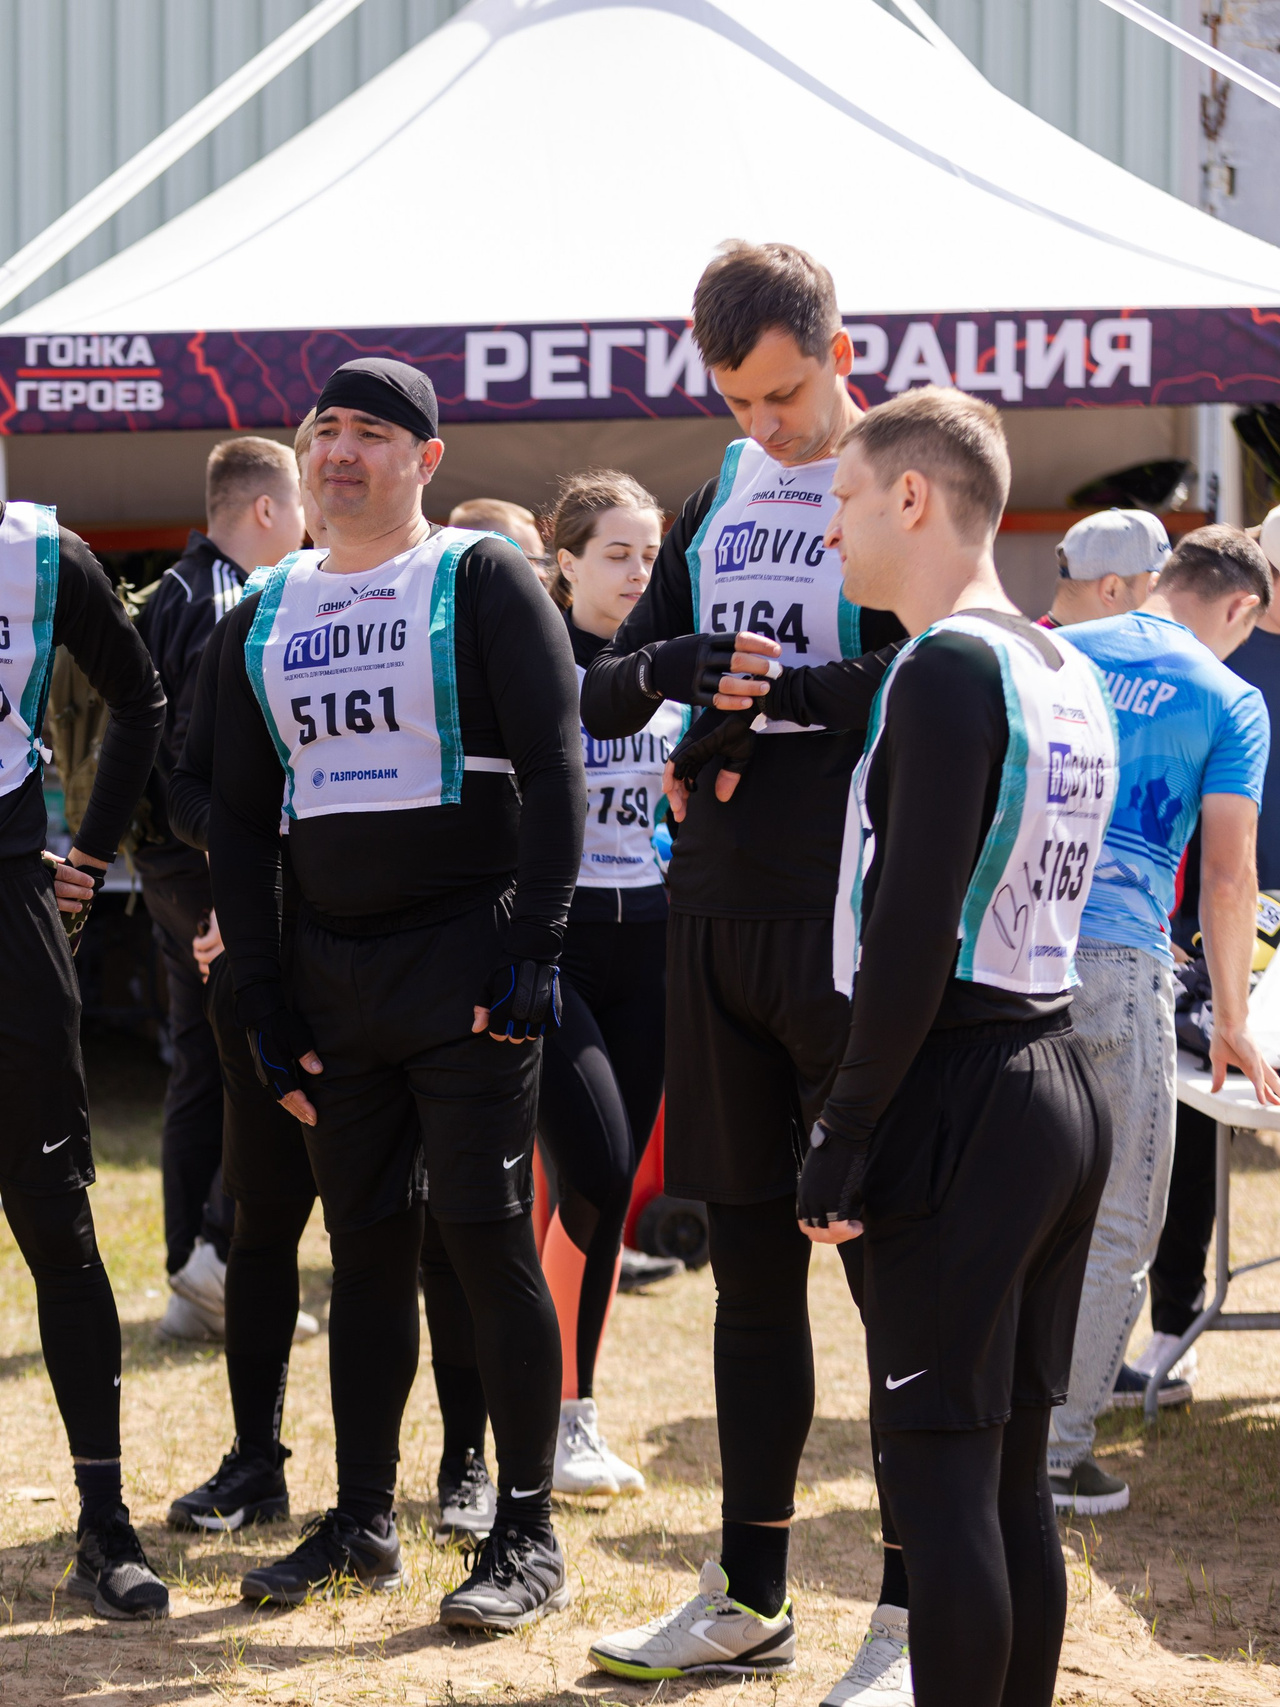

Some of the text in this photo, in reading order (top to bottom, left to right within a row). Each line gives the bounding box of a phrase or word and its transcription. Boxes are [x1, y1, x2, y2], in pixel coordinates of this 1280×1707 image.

[24, 336, 155, 367] ГОНКА
[465, 317, 1152, 401] РЕГИРАЦИЯ
[15, 381, 164, 411] ГЕРОЕВ
[778, 490, 823, 503] ГЕРОЕВ
[716, 526, 826, 568] RODVIG
[317, 588, 395, 614] ГОНКА ГЕРОЕВ
[287, 619, 407, 665] RODVIG
[711, 600, 810, 653] 5164
[290, 686, 400, 746] 5161
[330, 769, 398, 782] ГАЗПРОМБАНК
[587, 787, 649, 828] 159
